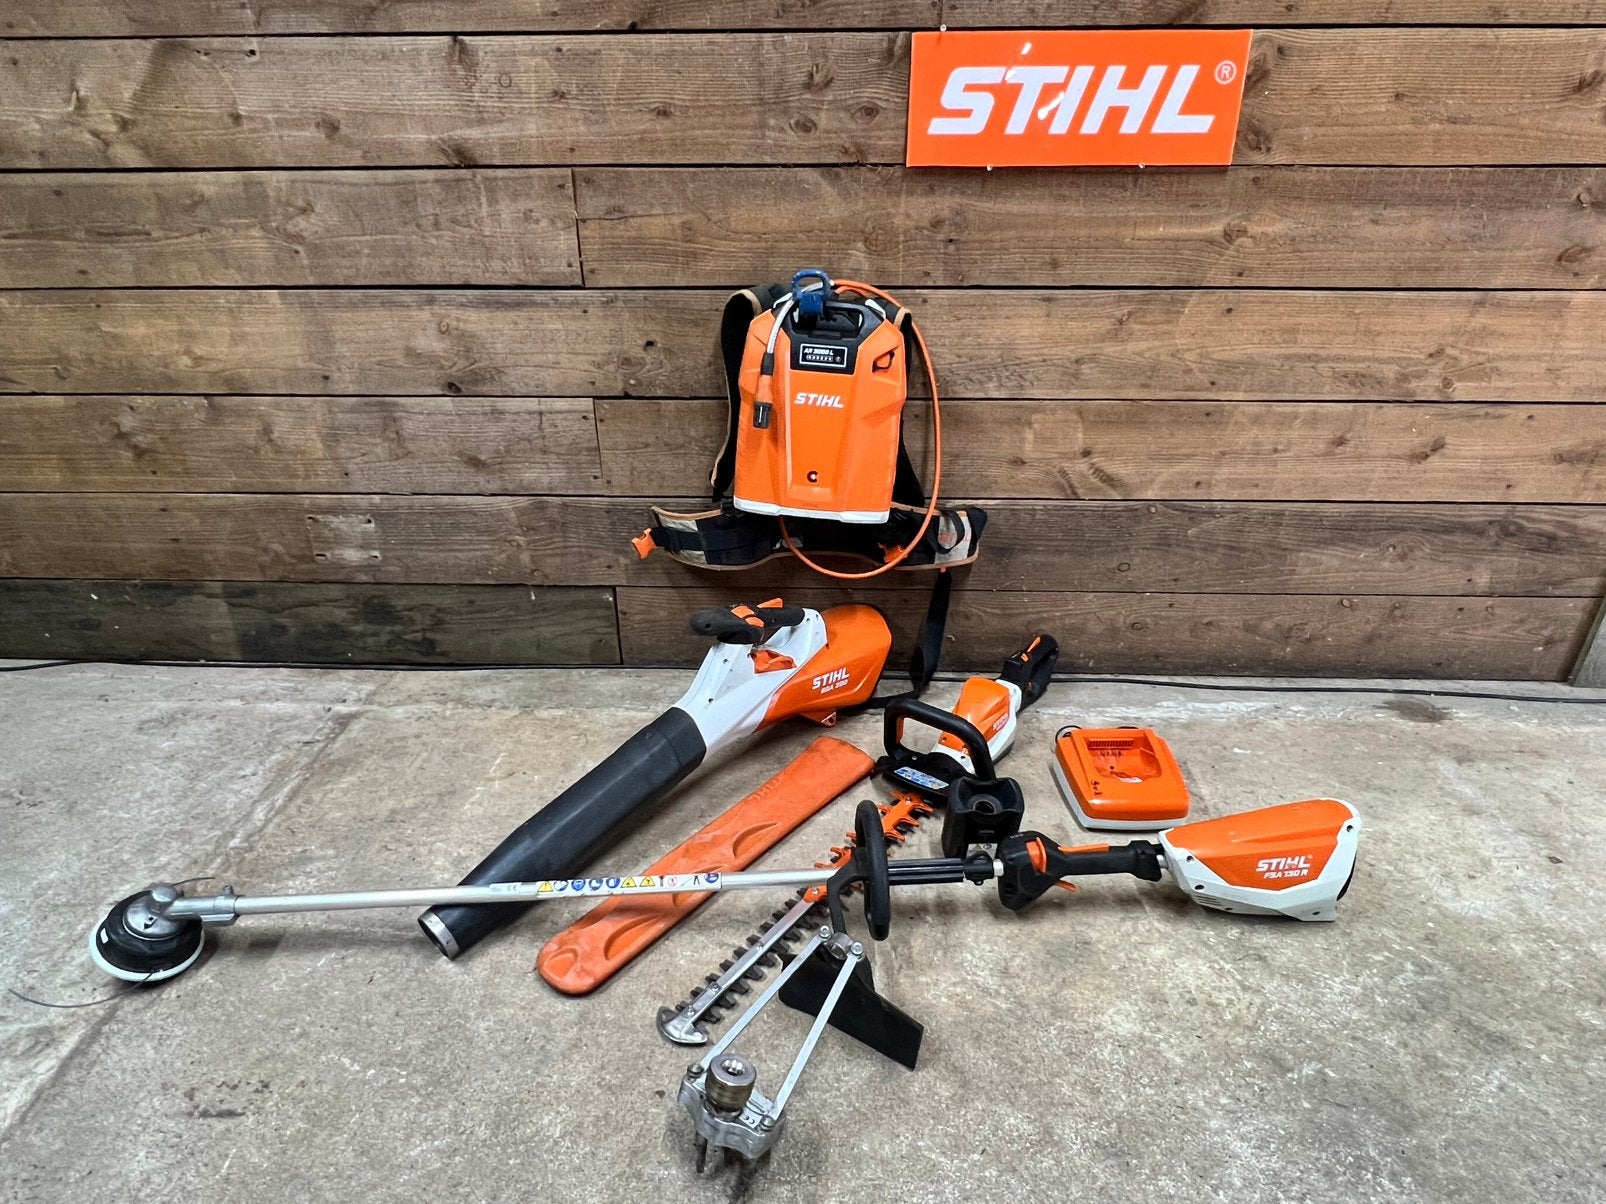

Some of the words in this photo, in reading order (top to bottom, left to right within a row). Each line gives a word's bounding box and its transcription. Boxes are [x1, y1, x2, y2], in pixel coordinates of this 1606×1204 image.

[927, 64, 1216, 135] STIHL
[794, 392, 845, 409] STIHL
[812, 667, 850, 690] STIHL
[1256, 855, 1311, 872] STIHL
[1284, 870, 1299, 878] 130
